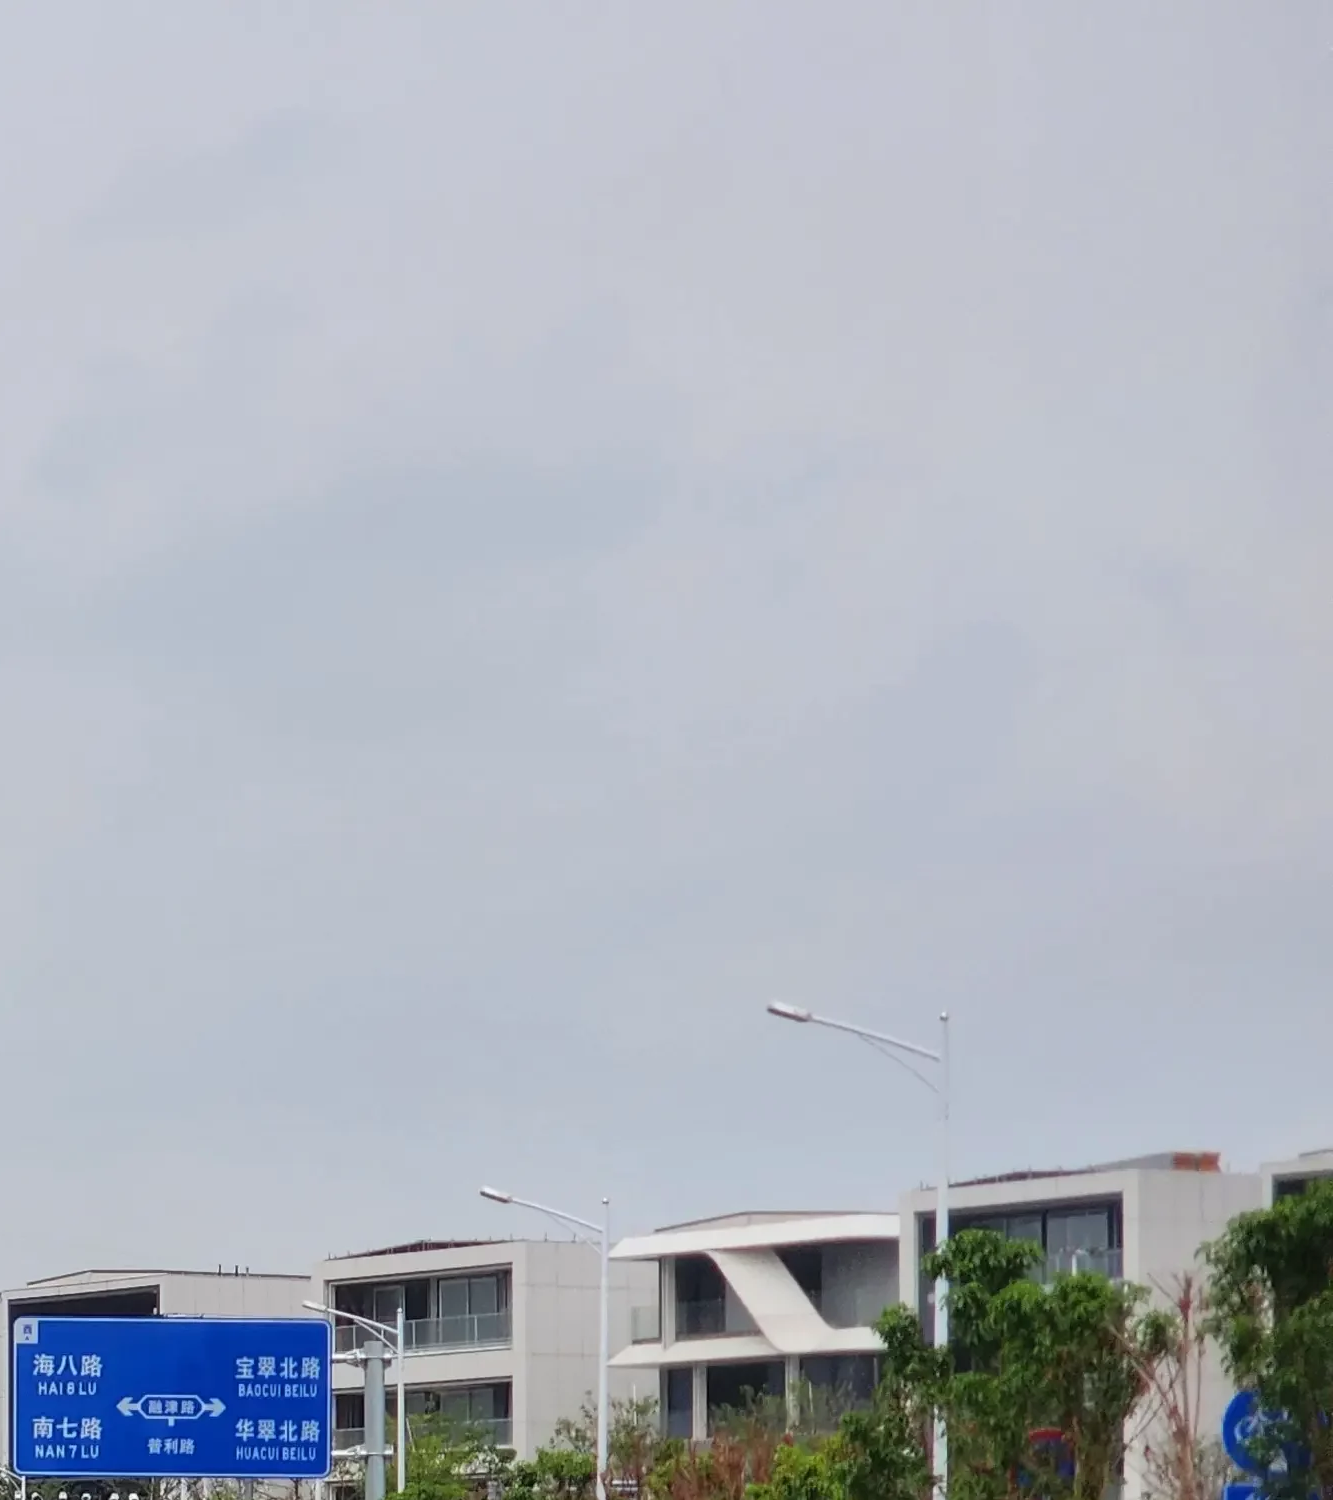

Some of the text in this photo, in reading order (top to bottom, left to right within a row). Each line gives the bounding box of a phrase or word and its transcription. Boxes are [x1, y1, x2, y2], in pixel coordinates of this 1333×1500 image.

[33, 1354, 102, 1377] 海八路
[235, 1356, 320, 1380] 宝翠北路
[38, 1381, 97, 1395] HAI 8 LU
[238, 1383, 318, 1398] BAOCUI BEILU
[32, 1416, 102, 1440] 南七路
[235, 1418, 320, 1443] 华翠北路
[35, 1444, 99, 1459] NAN 7 LU
[147, 1437, 195, 1455] 普利路
[236, 1446, 317, 1461] HUACUI BEILU
